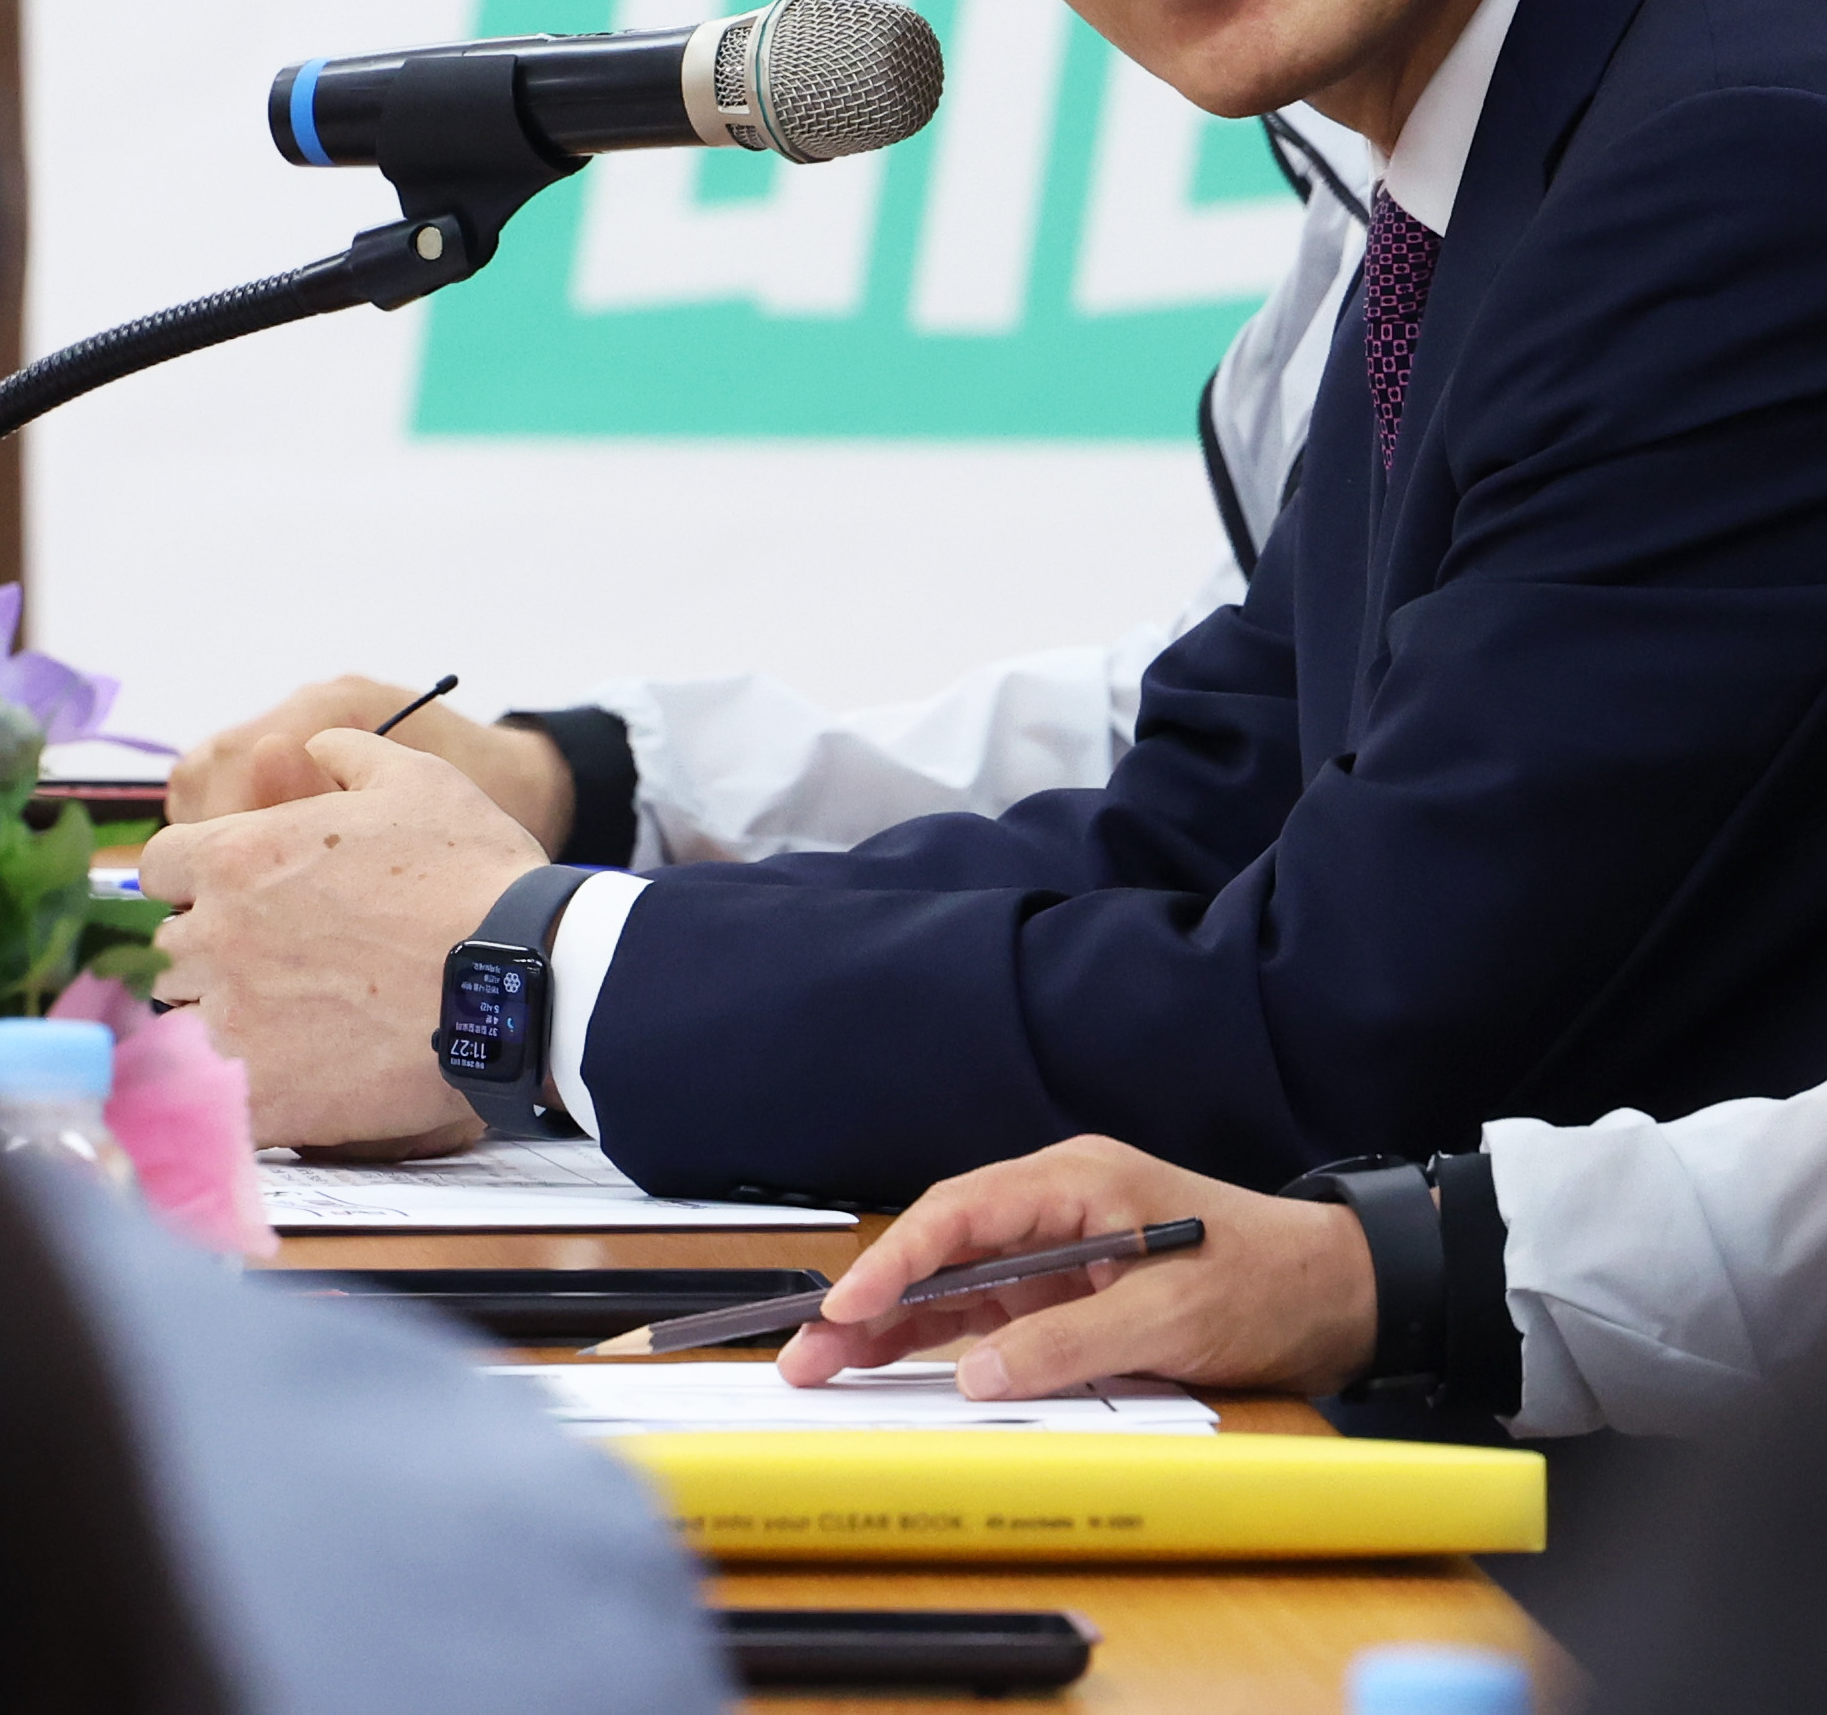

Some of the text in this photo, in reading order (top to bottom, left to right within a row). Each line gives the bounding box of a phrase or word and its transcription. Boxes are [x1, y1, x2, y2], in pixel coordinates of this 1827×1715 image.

[480, 1002, 493, 1012] 시간
[450, 1039, 487, 1059] 11:27
[818, 1512, 891, 1532] CLEAR
